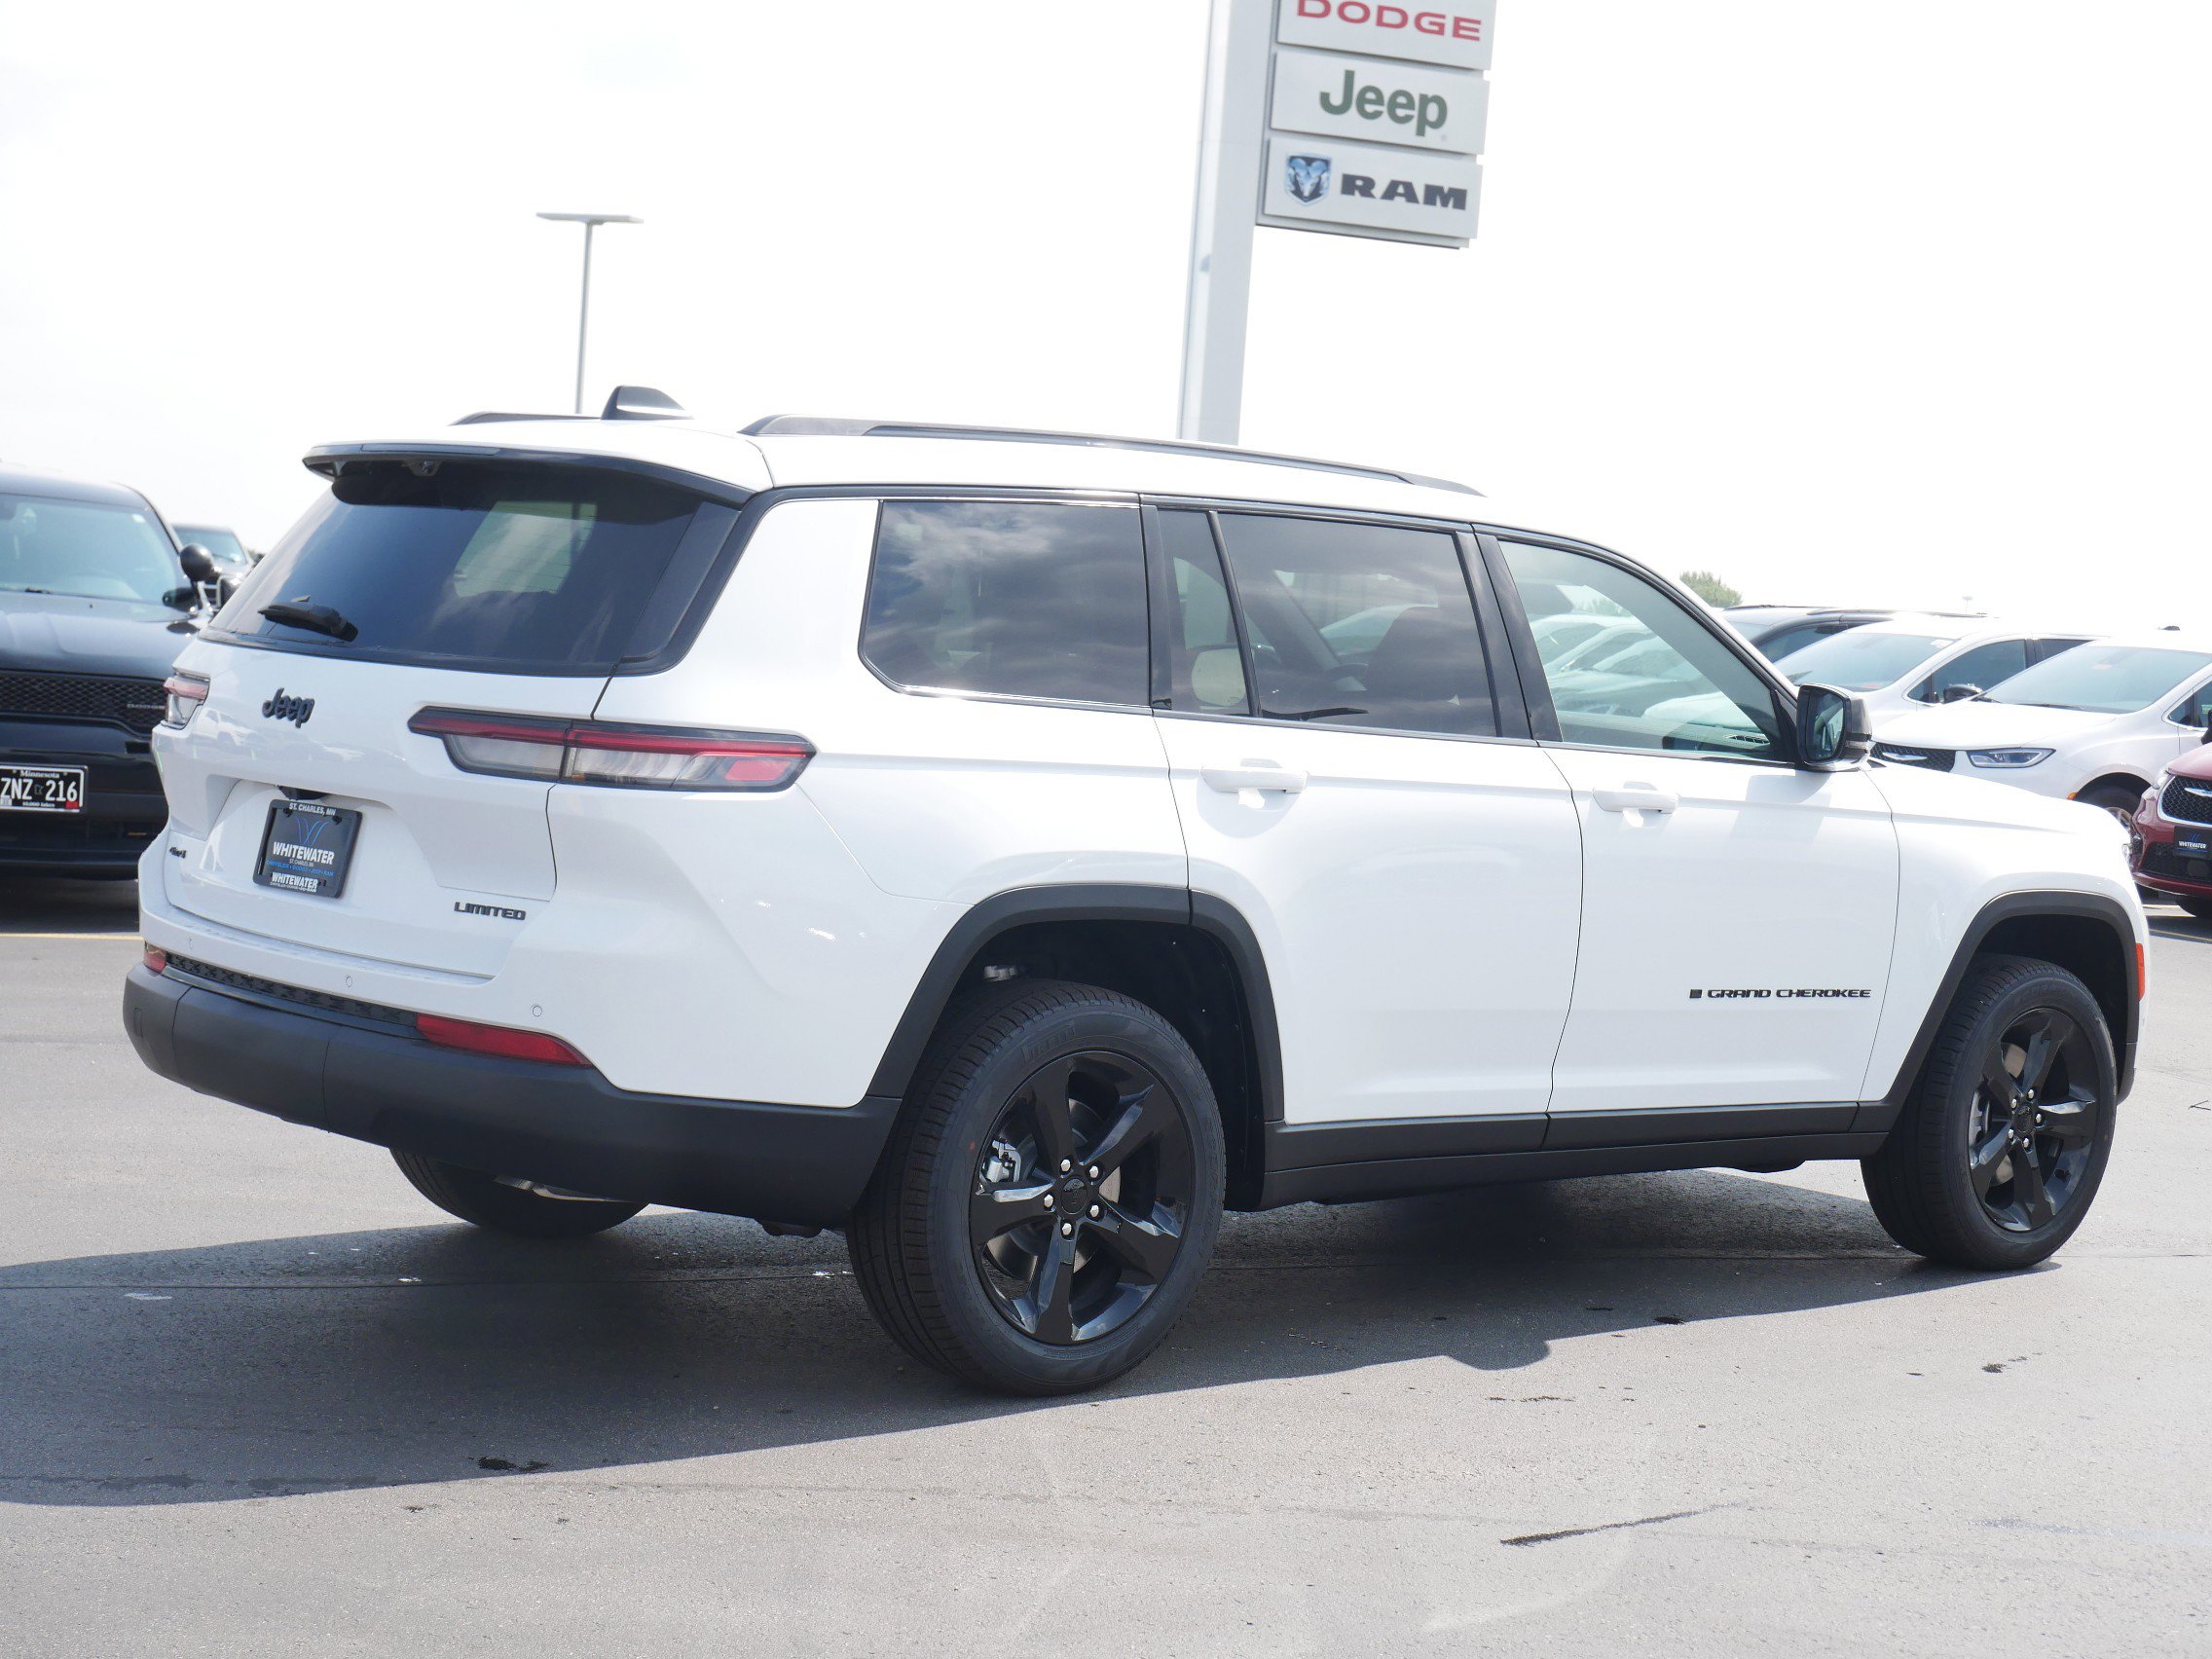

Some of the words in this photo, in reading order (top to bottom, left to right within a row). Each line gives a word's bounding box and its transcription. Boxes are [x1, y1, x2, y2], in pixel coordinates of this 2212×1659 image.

[1296, 0, 1482, 41] DODGE
[1319, 69, 1448, 136] Jeep
[1340, 172, 1468, 210] RAM
[262, 686, 314, 728] Jeep
[19, 769, 60, 779] Minnesota
[0, 777, 34, 800] ZNZ
[45, 779, 78, 802] 216
[298, 804, 325, 816] CHARLES,
[273, 841, 335, 865] WHITEWATER
[2178, 840, 2207, 849] WHITEWATER
[272, 871, 318, 889] WHITEWATER
[454, 902, 527, 921] LIMITED
[1707, 988, 1772, 999] GRAND
[1775, 988, 1872, 999] CHEROKEE
